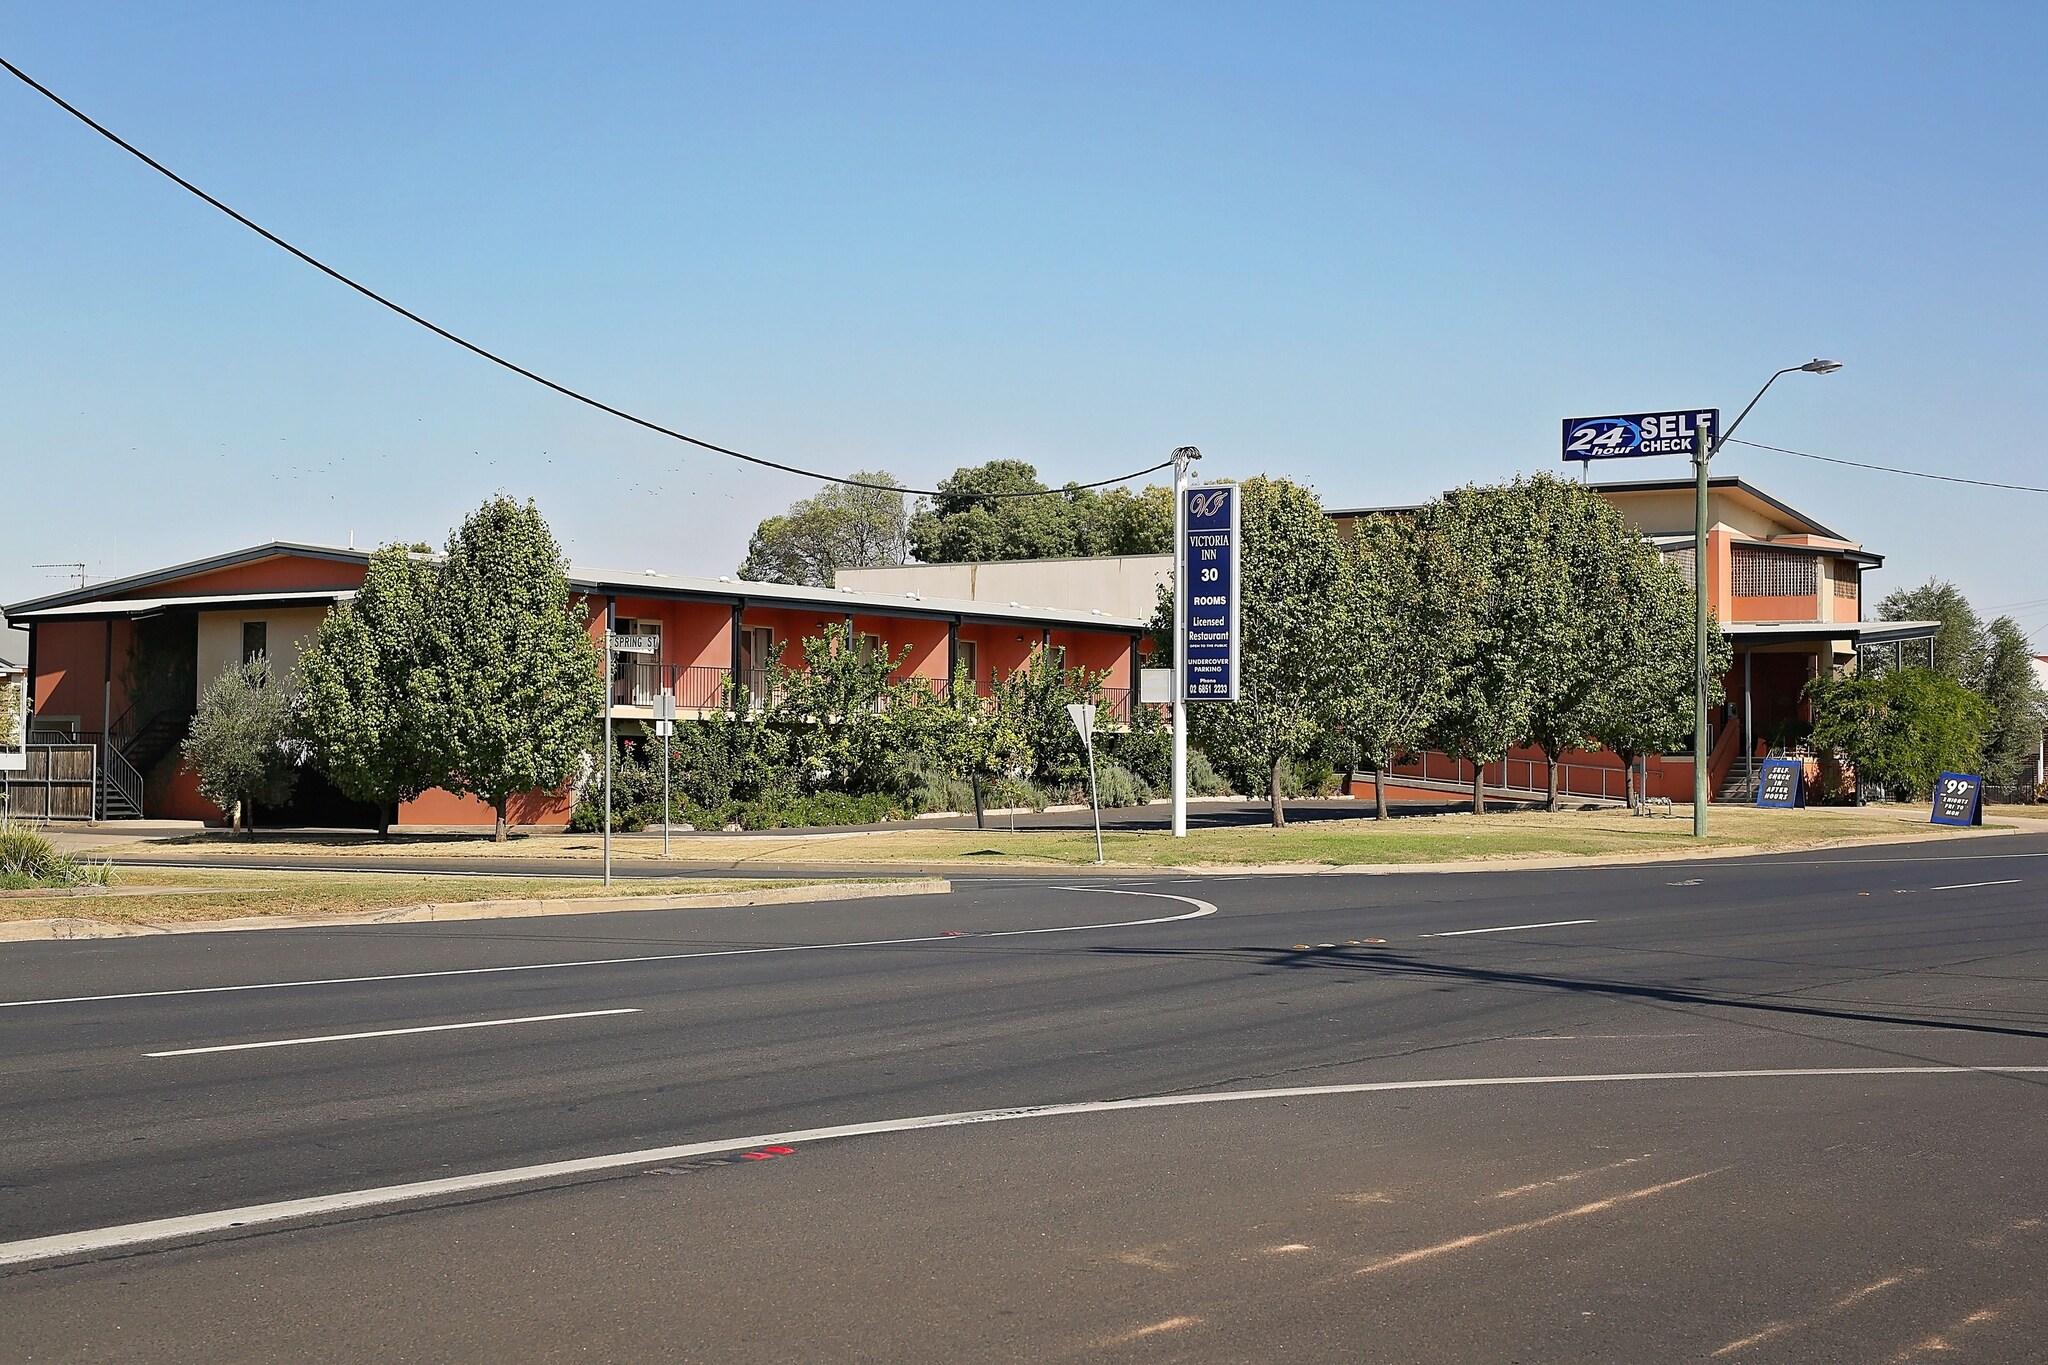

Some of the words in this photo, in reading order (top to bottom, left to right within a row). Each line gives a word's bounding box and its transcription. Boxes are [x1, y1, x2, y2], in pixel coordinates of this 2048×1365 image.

[1566, 426, 1625, 451] 24
[1591, 445, 1635, 456] hour
[1640, 438, 1692, 453] CHECK
[1190, 535, 1229, 547] VICTORIA
[1201, 549, 1217, 560] INN
[1201, 567, 1218, 582] 30
[1194, 596, 1226, 605] ROOMS
[1193, 616, 1224, 626] Licensed
[614, 636, 642, 647] SPRING
[1189, 631, 1229, 641] Restaurant
[1189, 684, 1197, 694] 02
[1213, 684, 1228, 694] 2233
